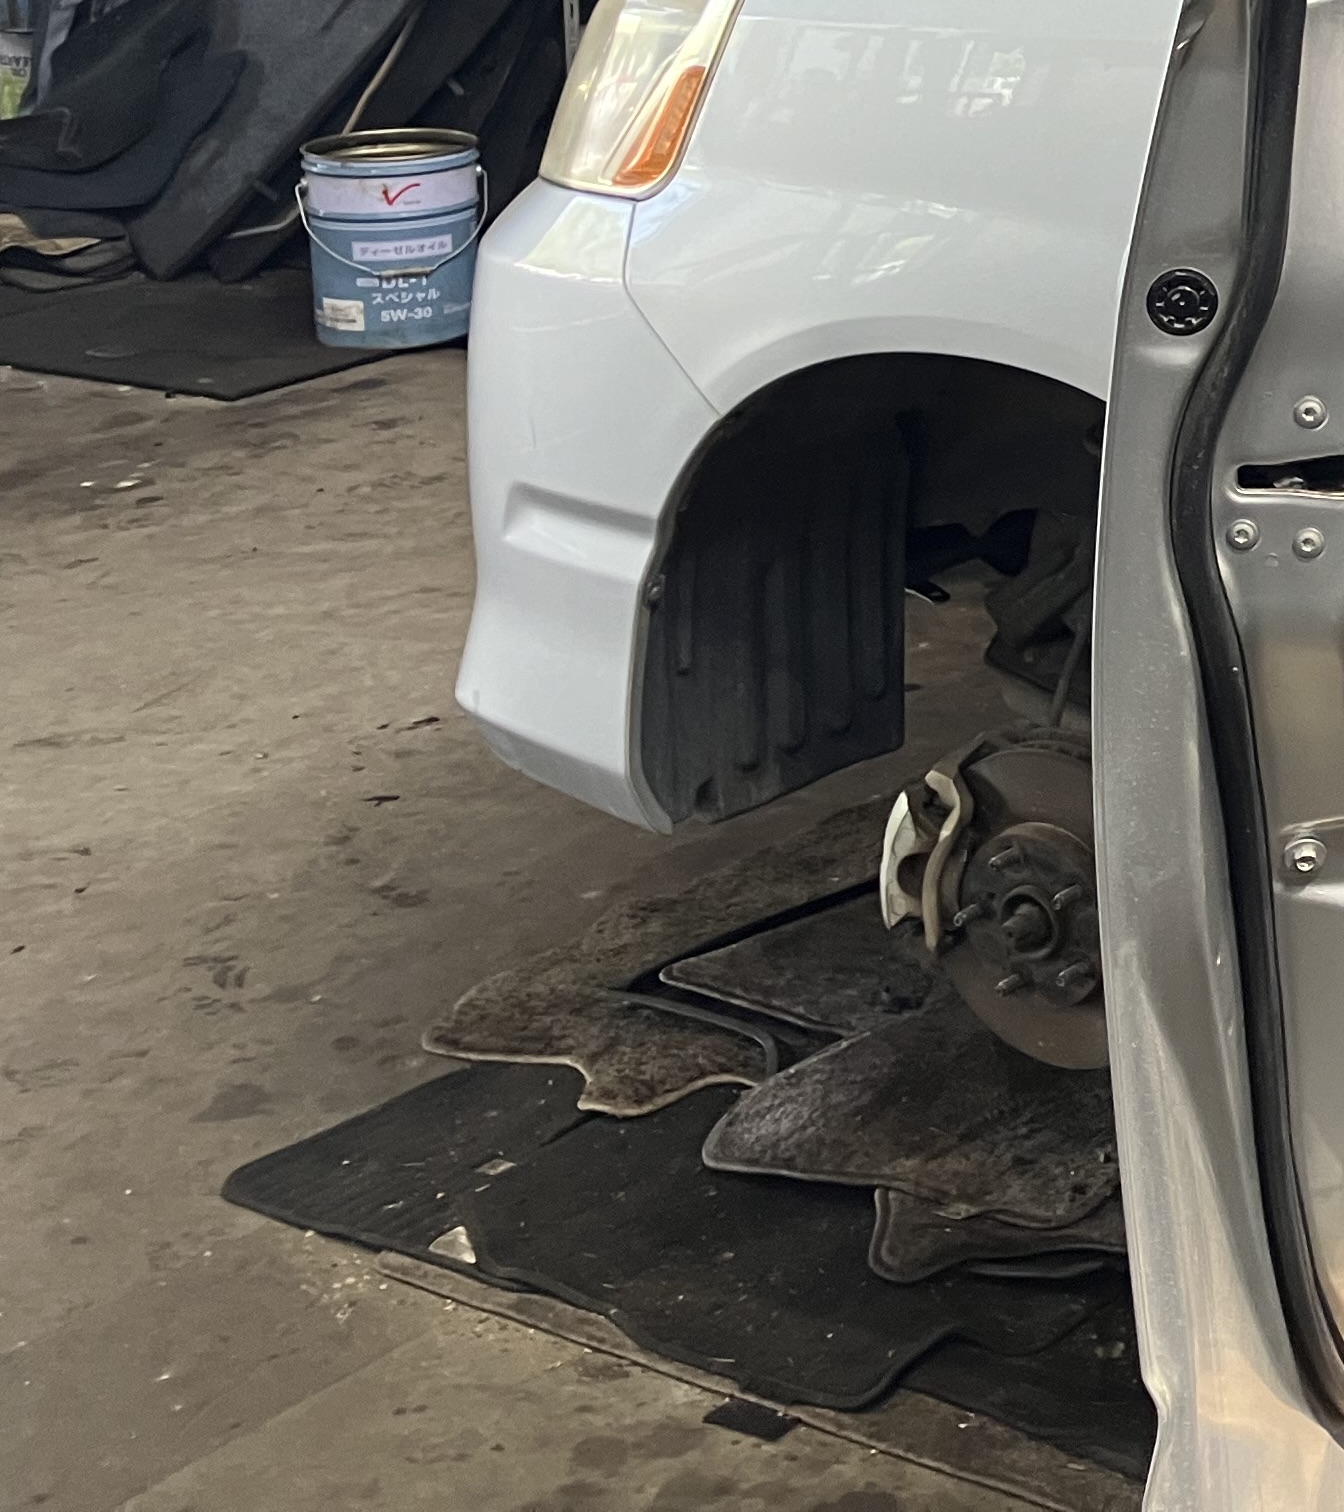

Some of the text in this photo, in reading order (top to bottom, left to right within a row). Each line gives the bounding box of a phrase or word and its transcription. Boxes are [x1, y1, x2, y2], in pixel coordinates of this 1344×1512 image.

[360, 241, 447, 256] ディーゼルオイル
[371, 288, 440, 305] スペシャル
[381, 306, 433, 322] 5W-30
